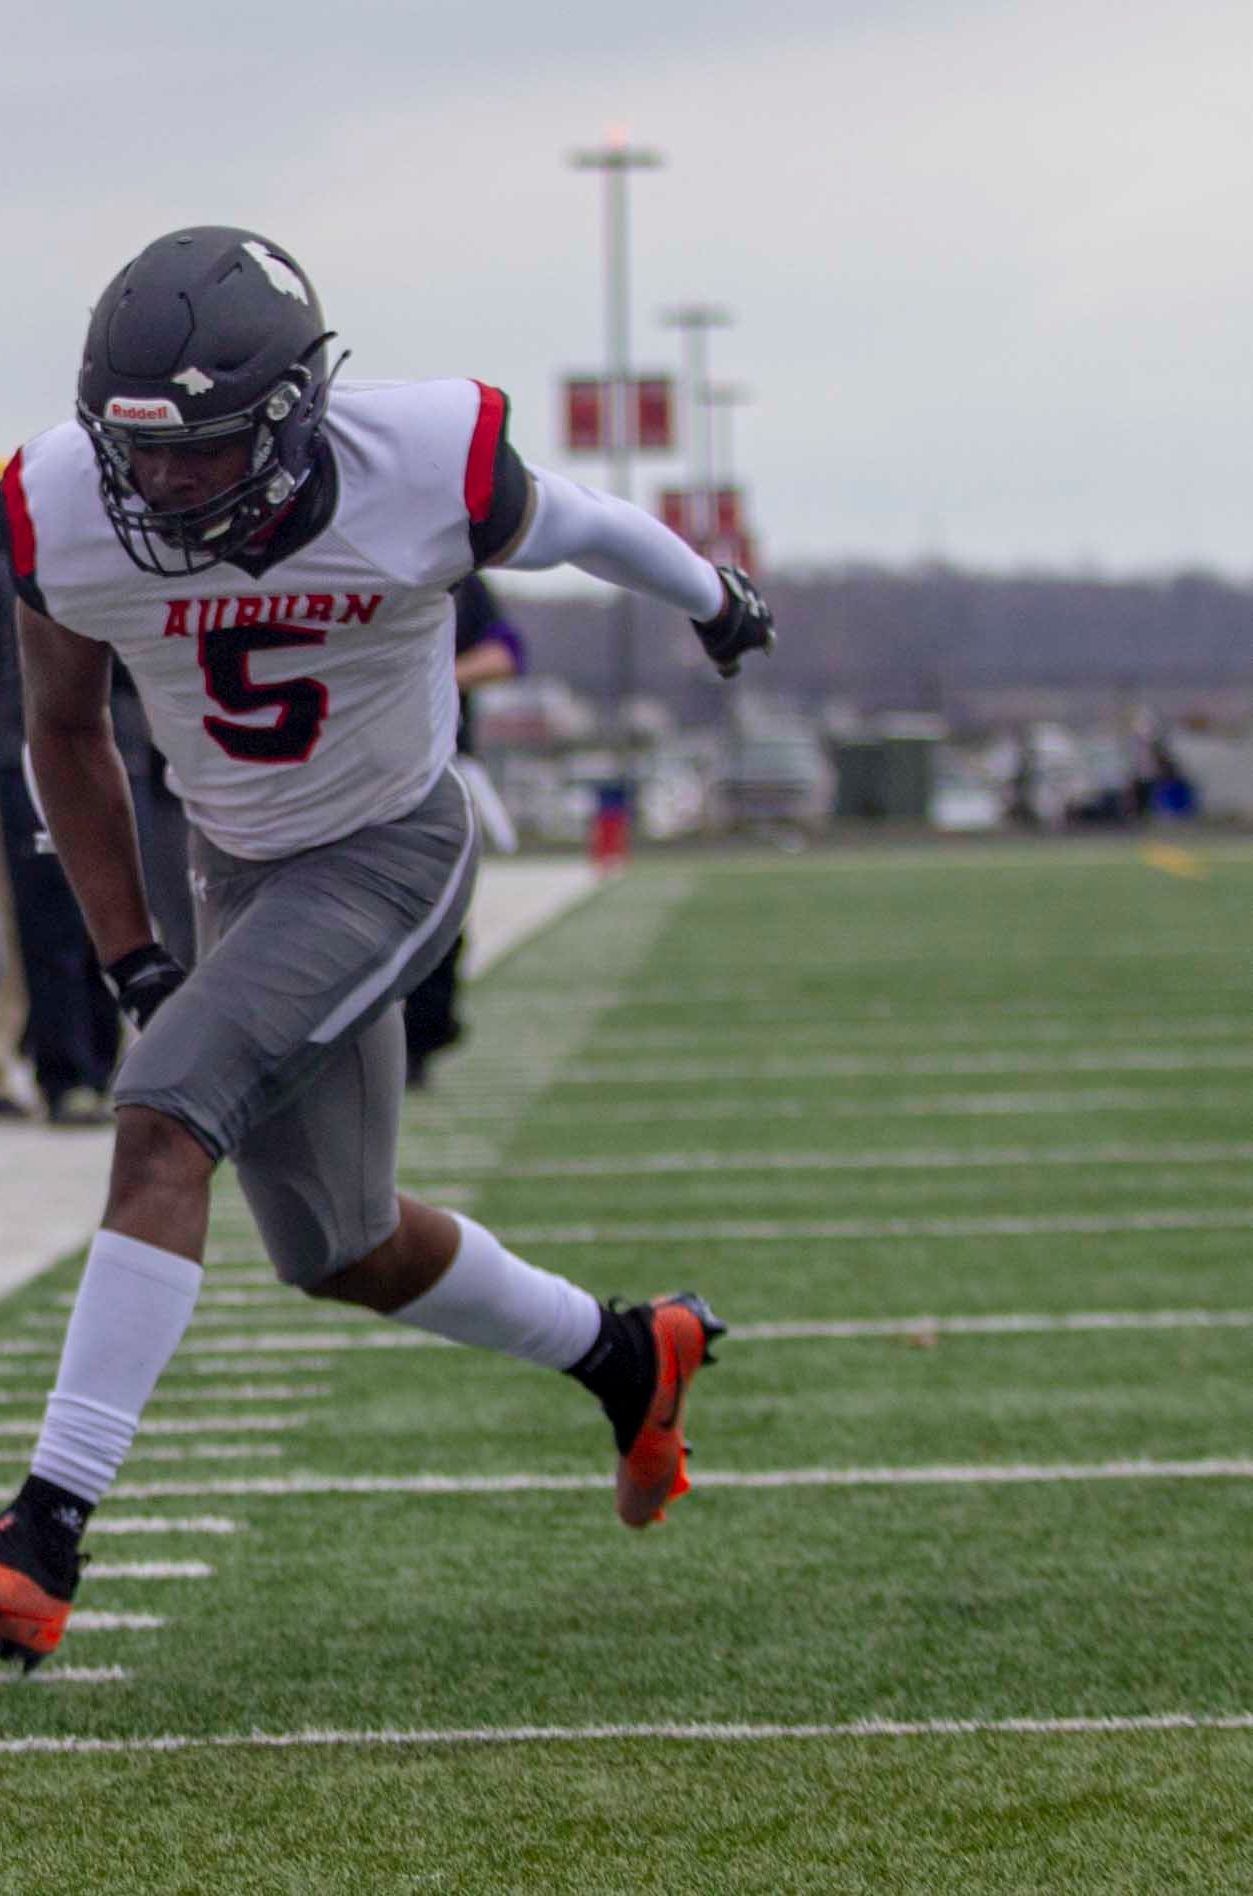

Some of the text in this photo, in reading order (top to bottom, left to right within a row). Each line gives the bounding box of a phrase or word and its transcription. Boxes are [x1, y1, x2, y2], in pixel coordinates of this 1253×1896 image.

[111, 403, 169, 419] Riddell
[162, 594, 383, 637] AUBURN
[201, 622, 329, 764] 5
